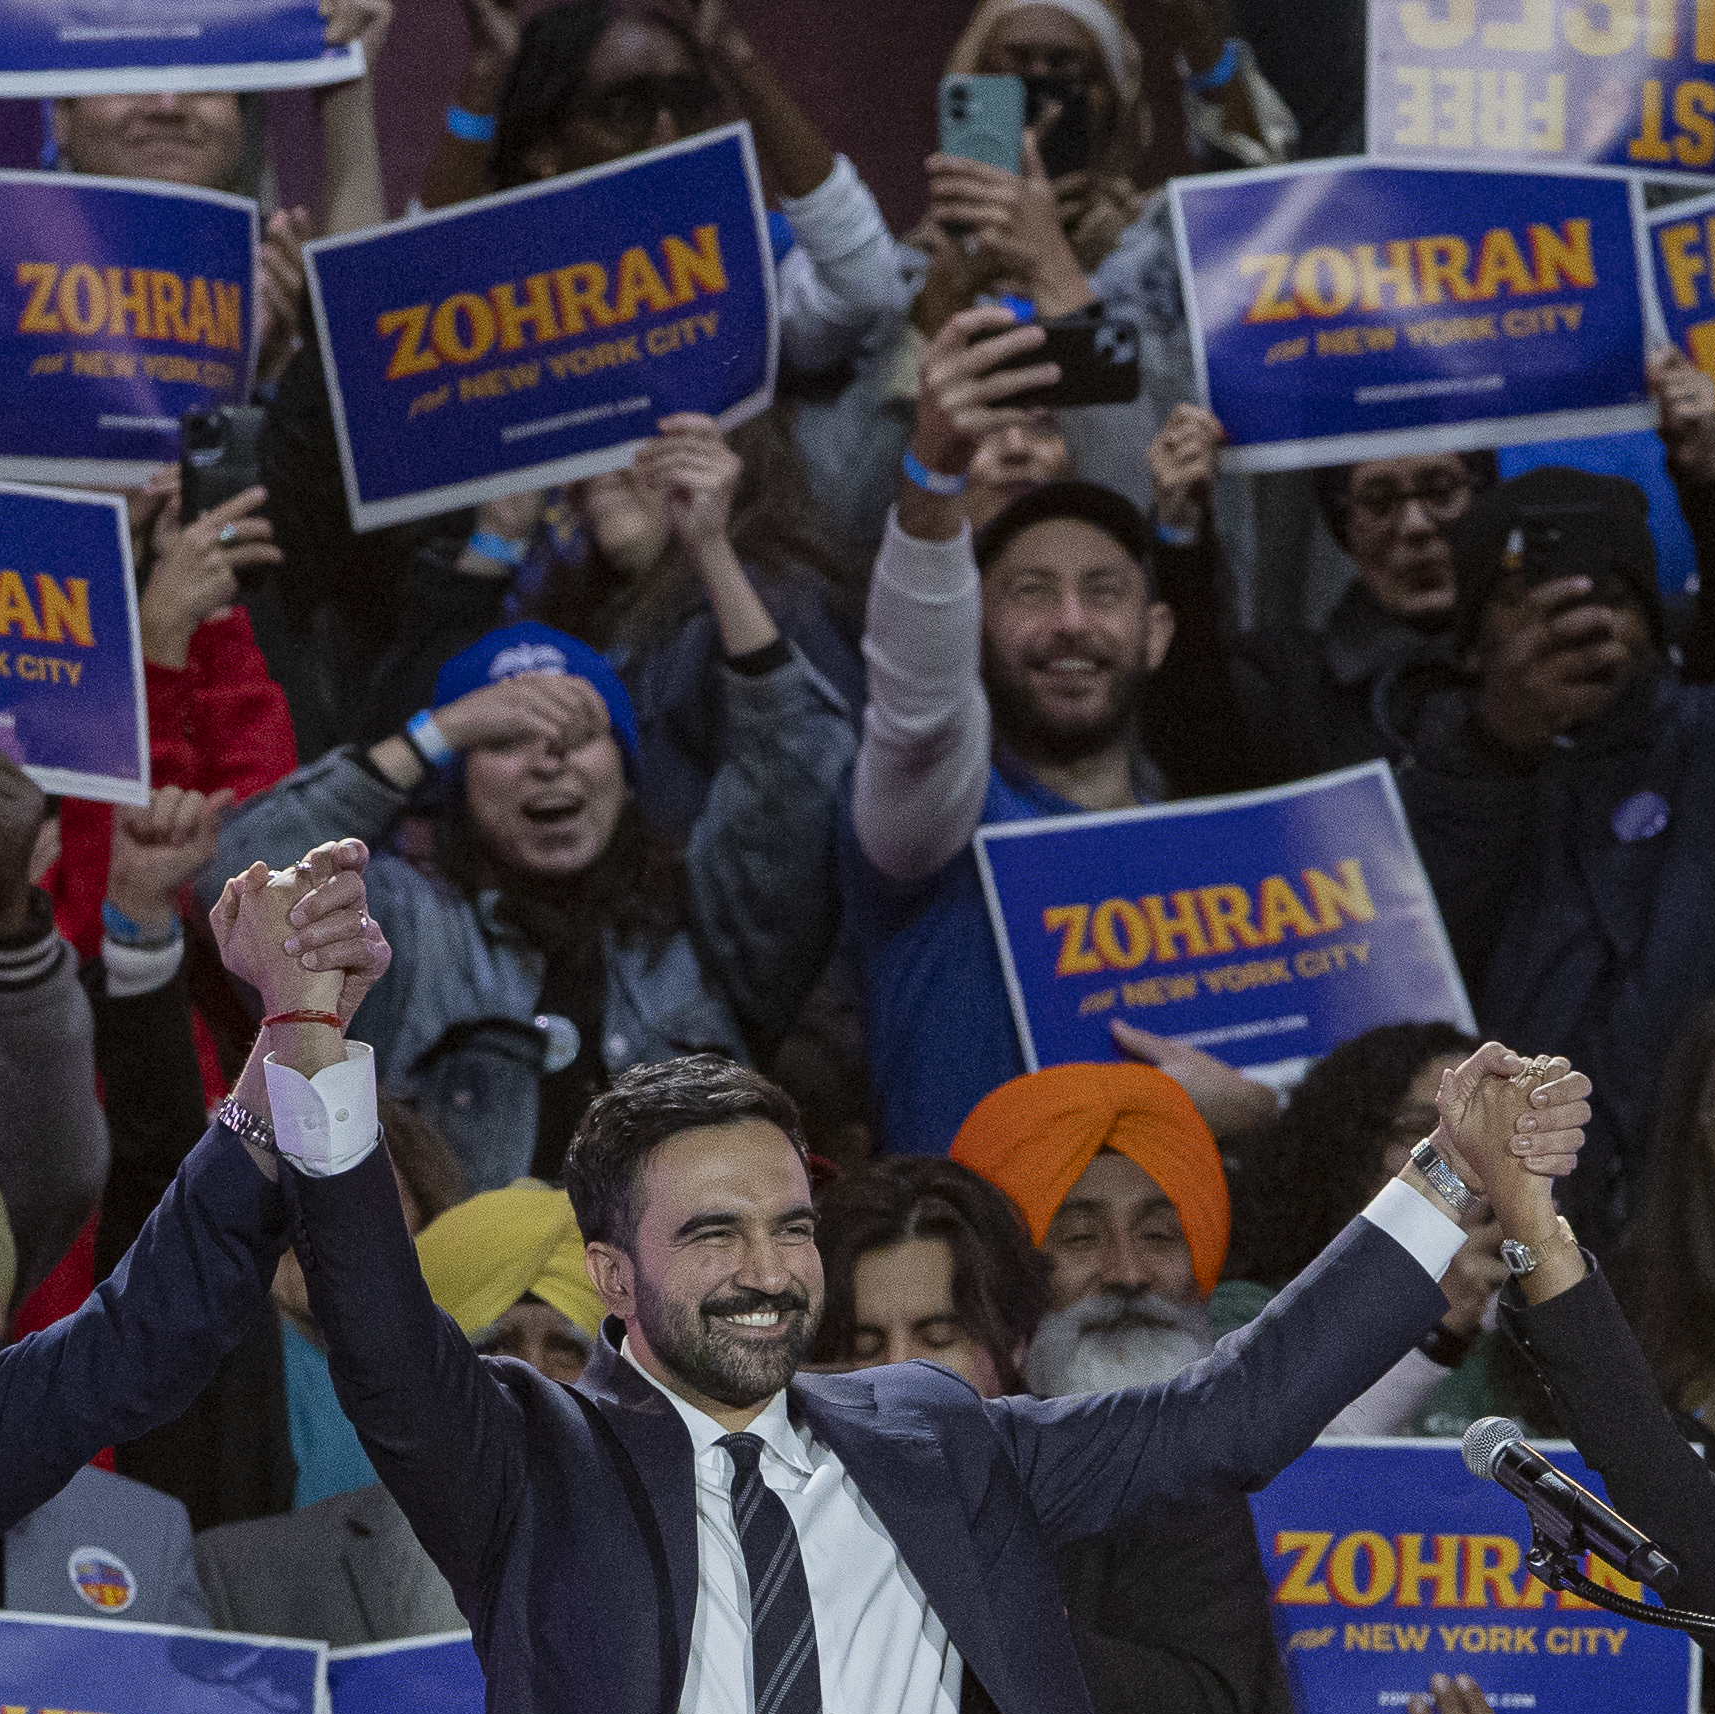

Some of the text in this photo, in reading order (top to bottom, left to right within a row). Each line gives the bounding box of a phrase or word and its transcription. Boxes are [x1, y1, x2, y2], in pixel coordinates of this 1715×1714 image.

[1394, 66, 1567, 151] FREE
[16, 261, 242, 350] ZOHRAN
[376, 224, 729, 380] ZOHRAN
[1239, 217, 1598, 325] ZOHRAN
[458, 360, 540, 401] NEW
[546, 335, 643, 380] YORK
[645, 311, 719, 357] CITY
[1316, 327, 1396, 356] NEW
[1502, 303, 1584, 338] CITY
[15, 653, 83, 686] CITY
[1043, 860, 1376, 979] ZOHRAN
[1123, 973, 1197, 1008] NEW
[1203, 958, 1292, 995] YORK
[1295, 941, 1370, 981] CITY
[1343, 1624, 1430, 1653] NEW
[1438, 1625, 1538, 1654] YORK
[1545, 1627, 1628, 1655] CITY
